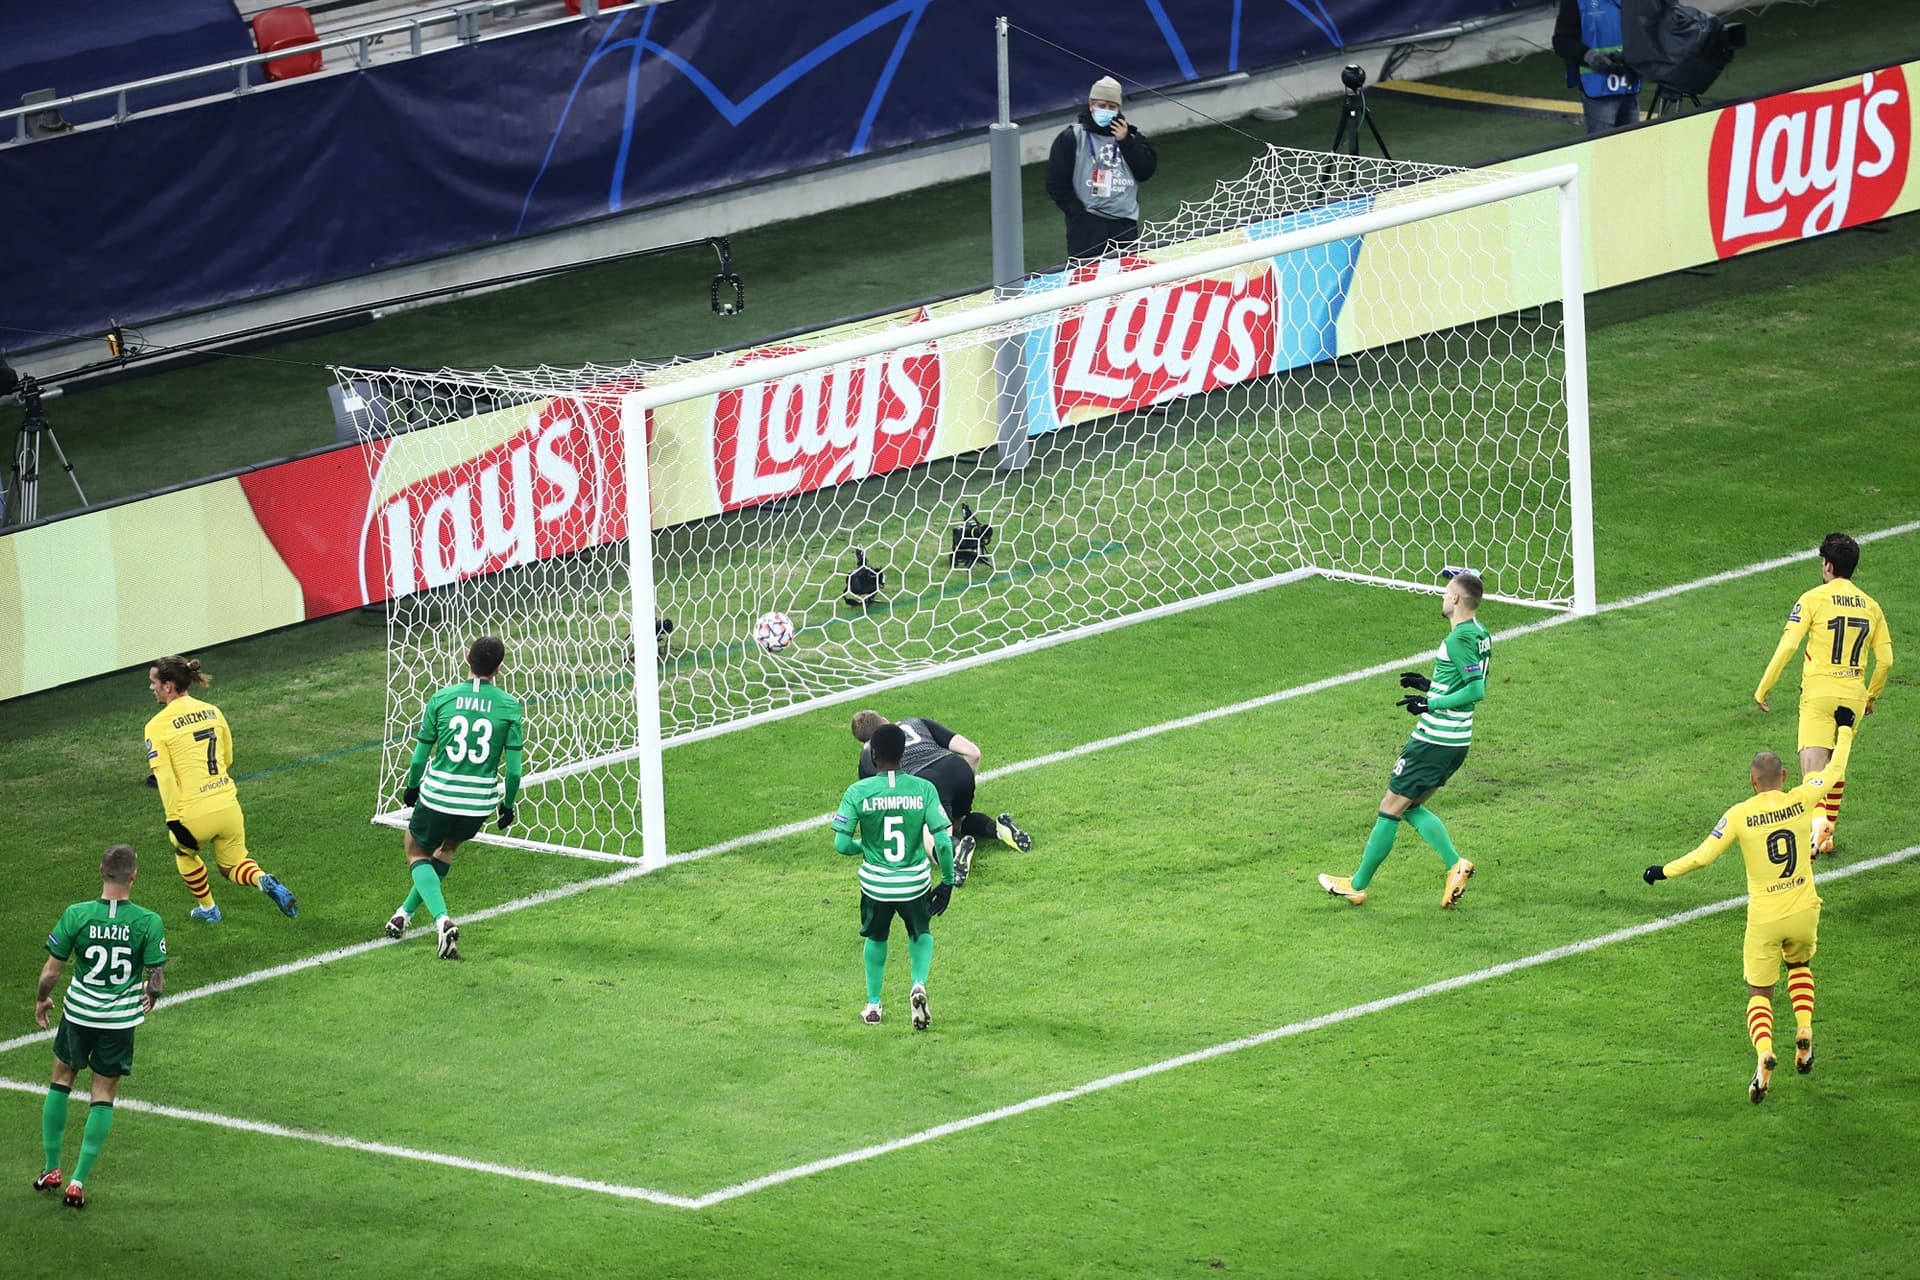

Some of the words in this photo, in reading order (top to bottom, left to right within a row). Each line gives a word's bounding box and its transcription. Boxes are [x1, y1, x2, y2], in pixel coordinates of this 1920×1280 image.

[1722, 72, 1900, 242] Lay's
[1085, 177, 1135, 187] CPIONS
[1063, 258, 1269, 404] Lay's
[1827, 615, 1870, 667] 17
[455, 696, 492, 713] DVALI
[192, 727, 219, 775] 7
[446, 715, 493, 764] 33
[862, 795, 924, 812] A.FRIMPONG
[1746, 802, 1805, 827] BRAITHWAITE
[883, 815, 906, 863] 5
[1766, 828, 1797, 879] 9
[1766, 879, 1796, 893] unicef
[89, 925, 130, 941] BLAŽIČ
[83, 944, 132, 986] 25
